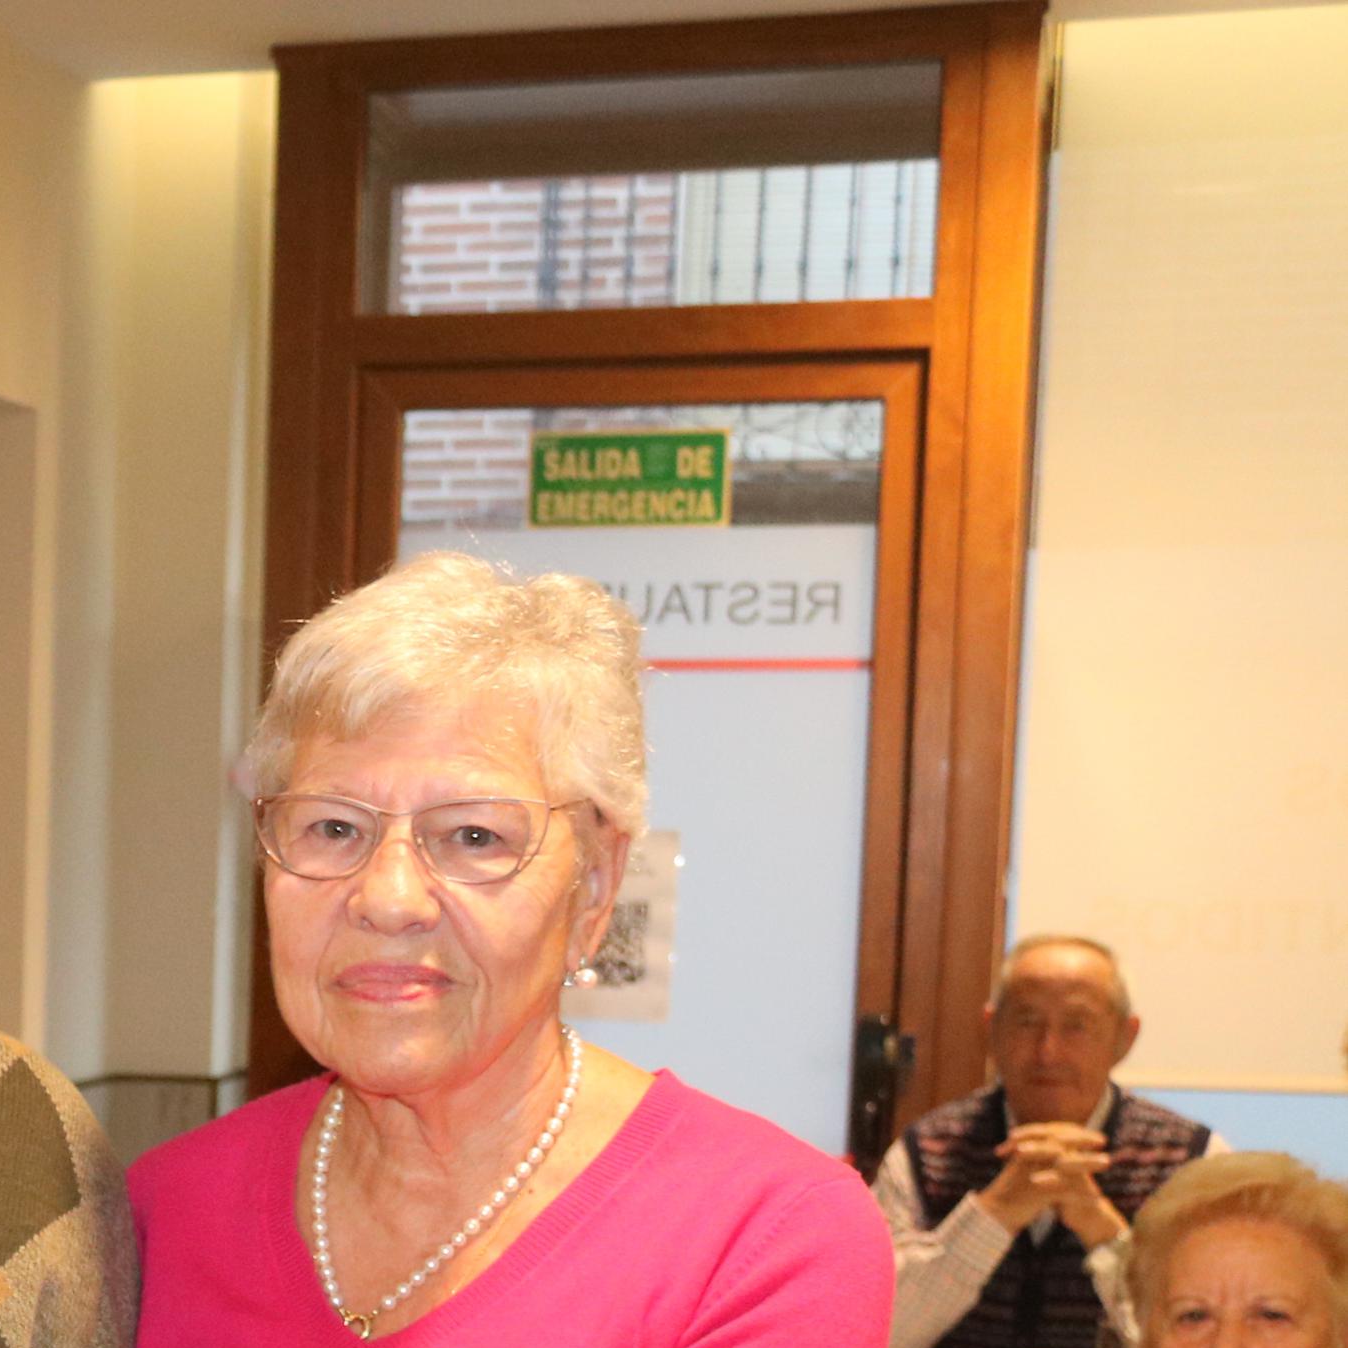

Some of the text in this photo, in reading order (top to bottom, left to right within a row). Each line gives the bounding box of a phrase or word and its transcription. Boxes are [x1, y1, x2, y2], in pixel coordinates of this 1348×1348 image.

[544, 445, 715, 481] SALIDA DE
[537, 488, 716, 521] EMERGENCIA
